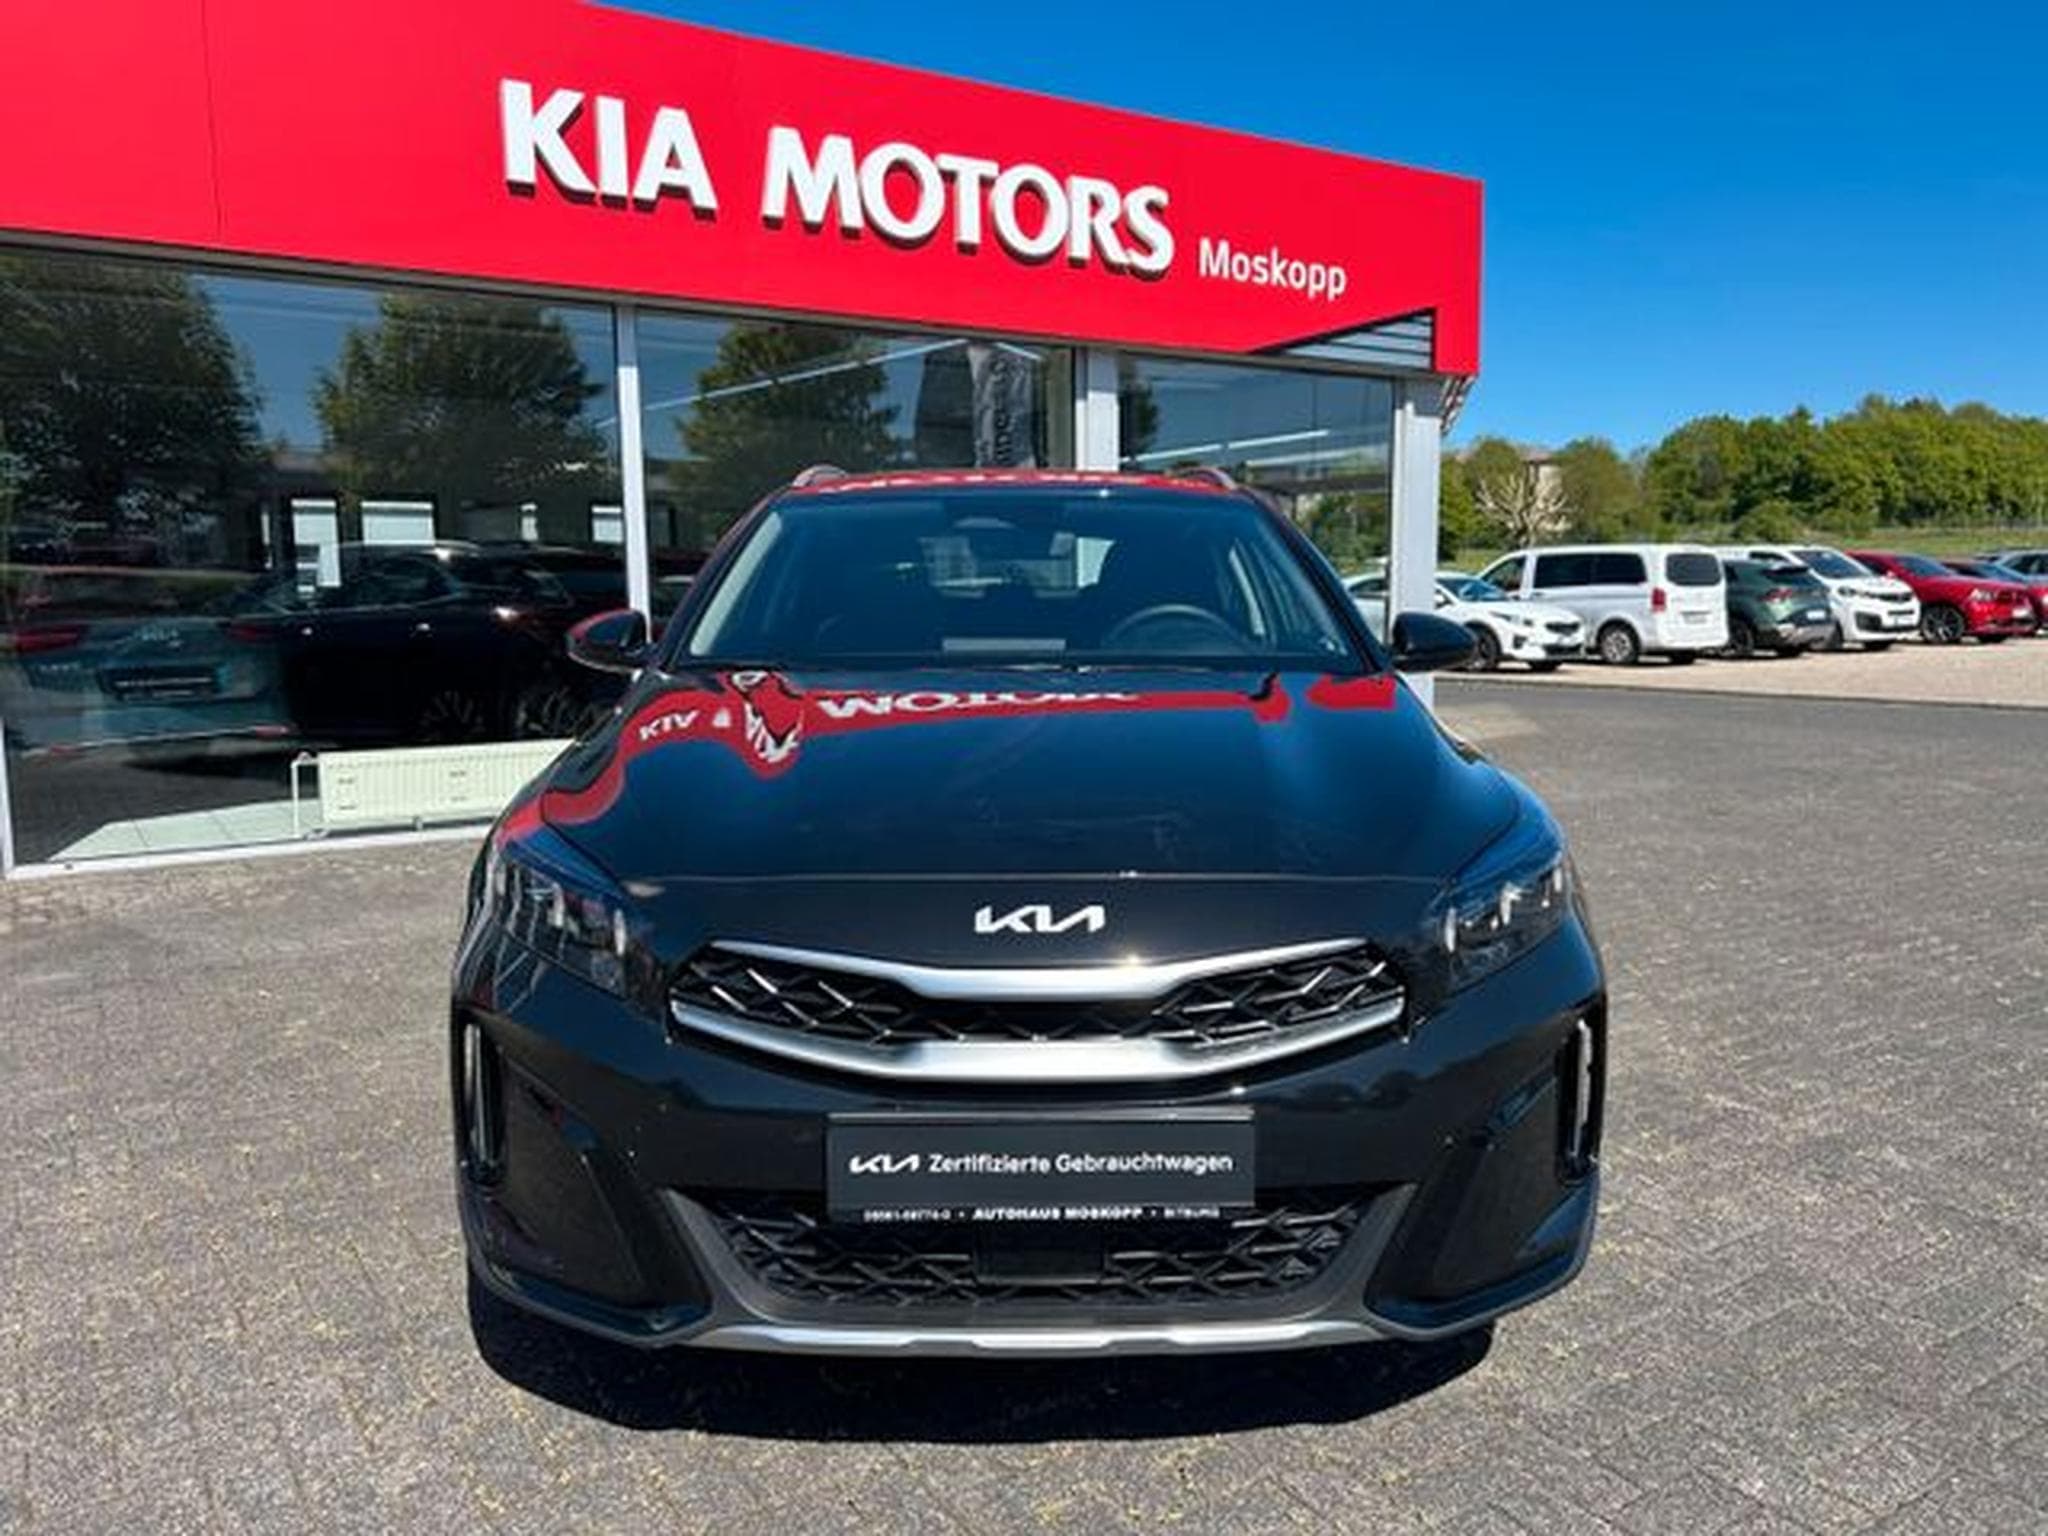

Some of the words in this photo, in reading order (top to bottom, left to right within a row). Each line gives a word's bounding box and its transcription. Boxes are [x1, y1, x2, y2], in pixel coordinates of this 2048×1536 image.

[501, 79, 718, 216] KIA
[761, 124, 1176, 278] MOTORS
[1198, 235, 1347, 301] Moskopp
[974, 904, 1106, 933] KIA
[849, 1153, 920, 1174] KIA
[928, 1153, 1050, 1174] Zertifizierte
[1055, 1152, 1234, 1175] Gebrauchtwagen
[972, 1206, 1060, 1220] AUTOHAUS
[1064, 1207, 1143, 1220] MOSKOPP
